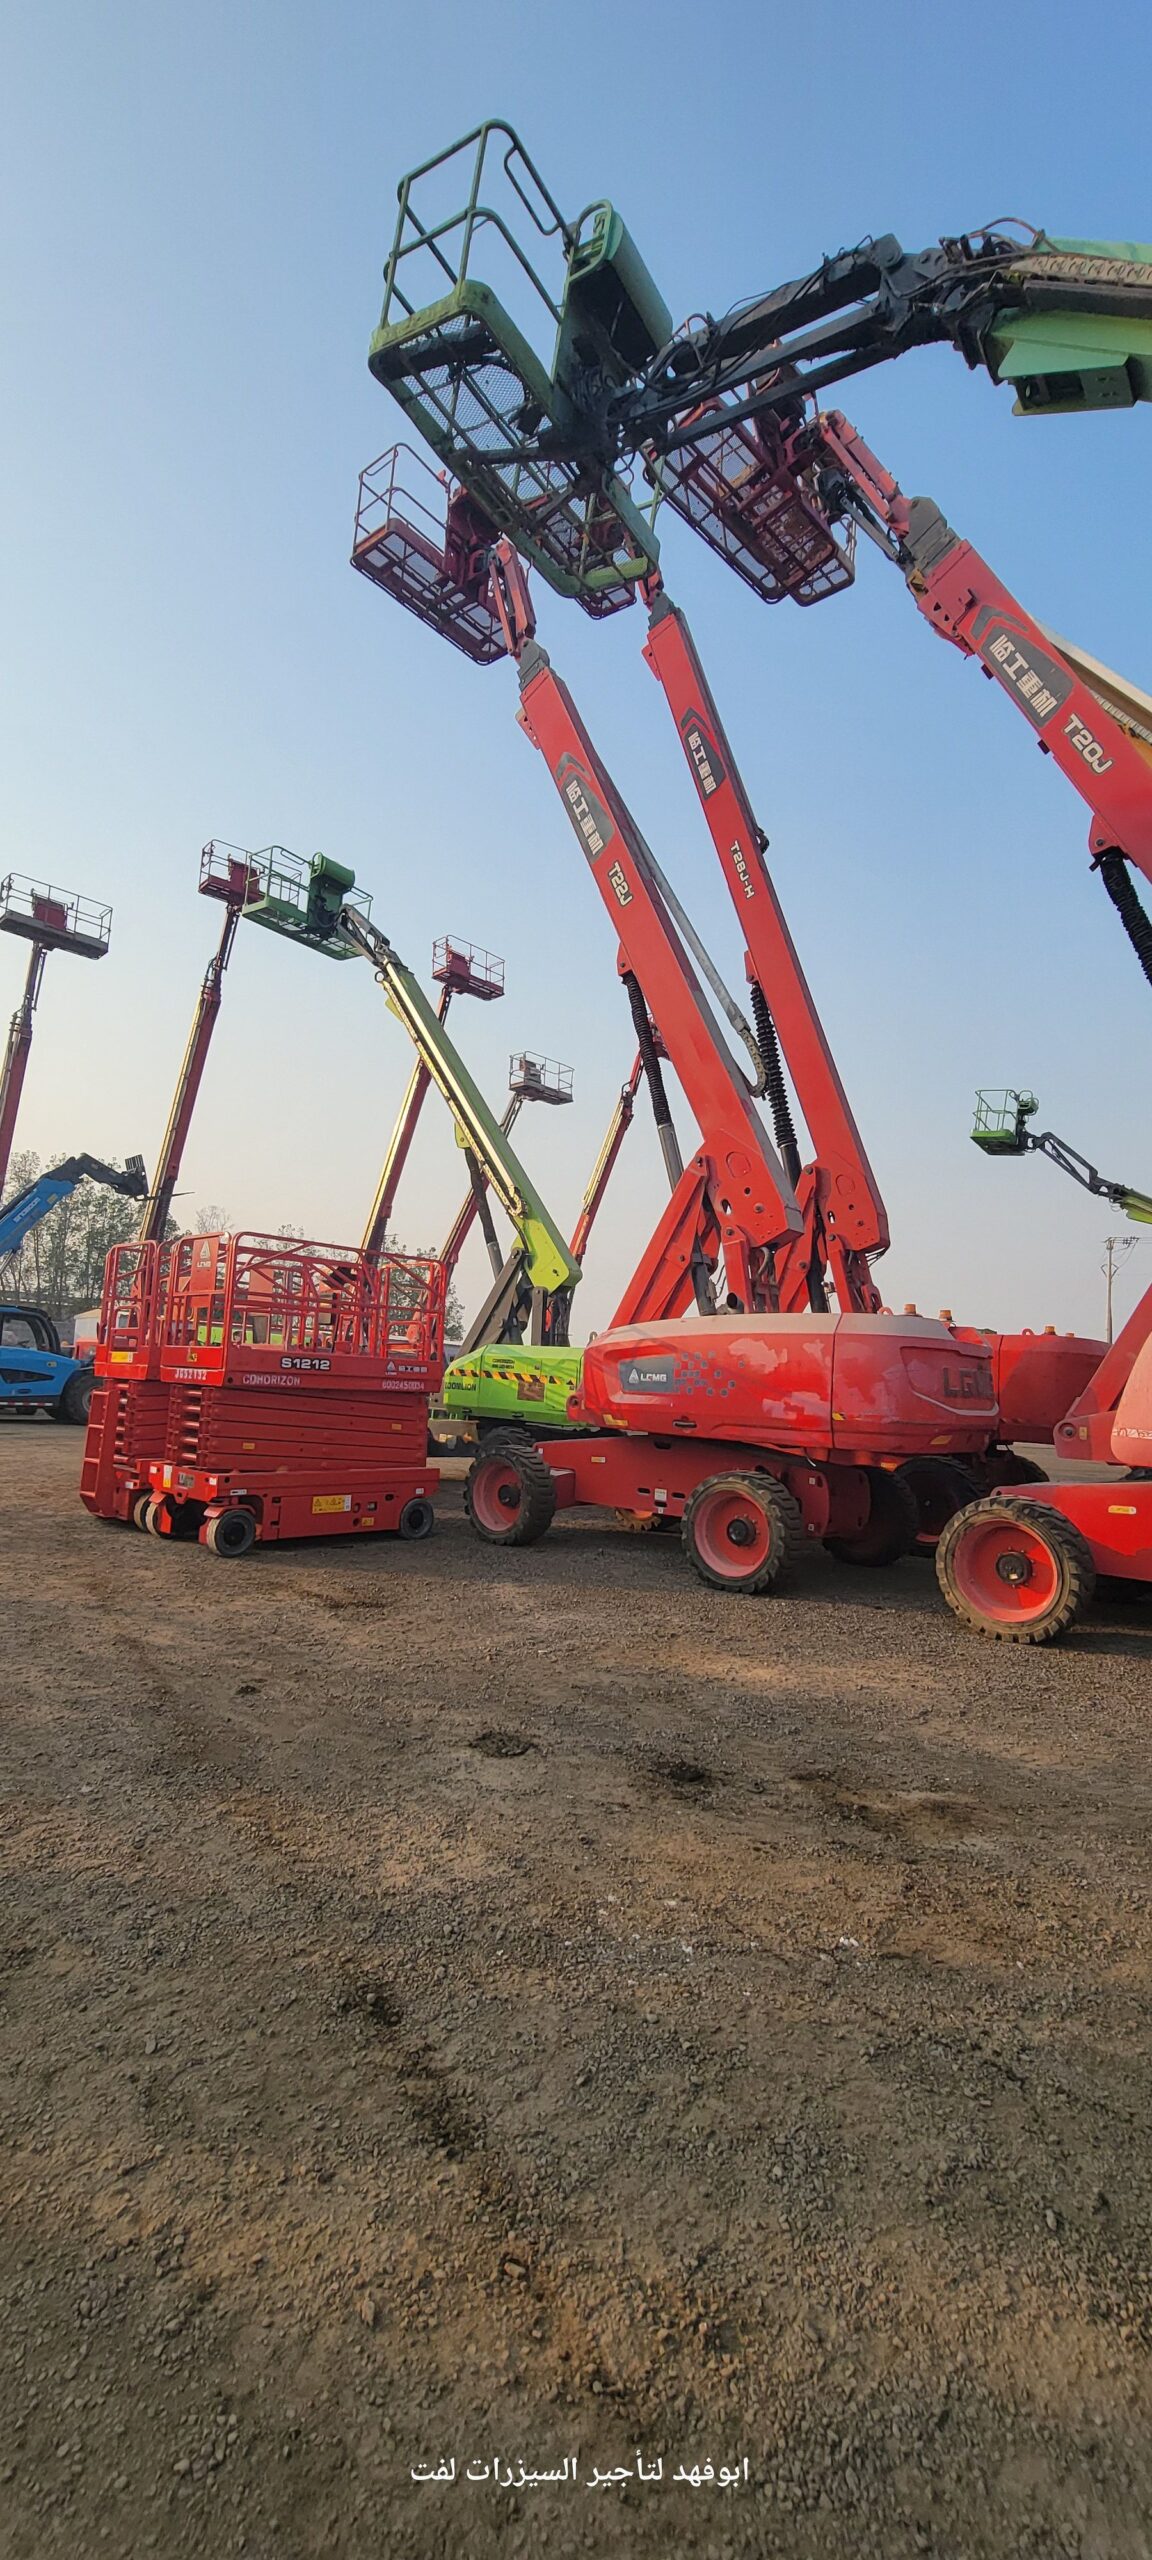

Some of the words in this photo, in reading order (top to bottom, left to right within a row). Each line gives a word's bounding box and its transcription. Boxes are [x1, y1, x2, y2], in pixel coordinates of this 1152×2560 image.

[989, 634, 1058, 718] 临工重机
[1063, 713, 1113, 774] T20J
[608, 861, 633, 906] T22J
[243, 1374, 300, 1386] COHORIZON
[281, 1357, 331, 1370] S1212
